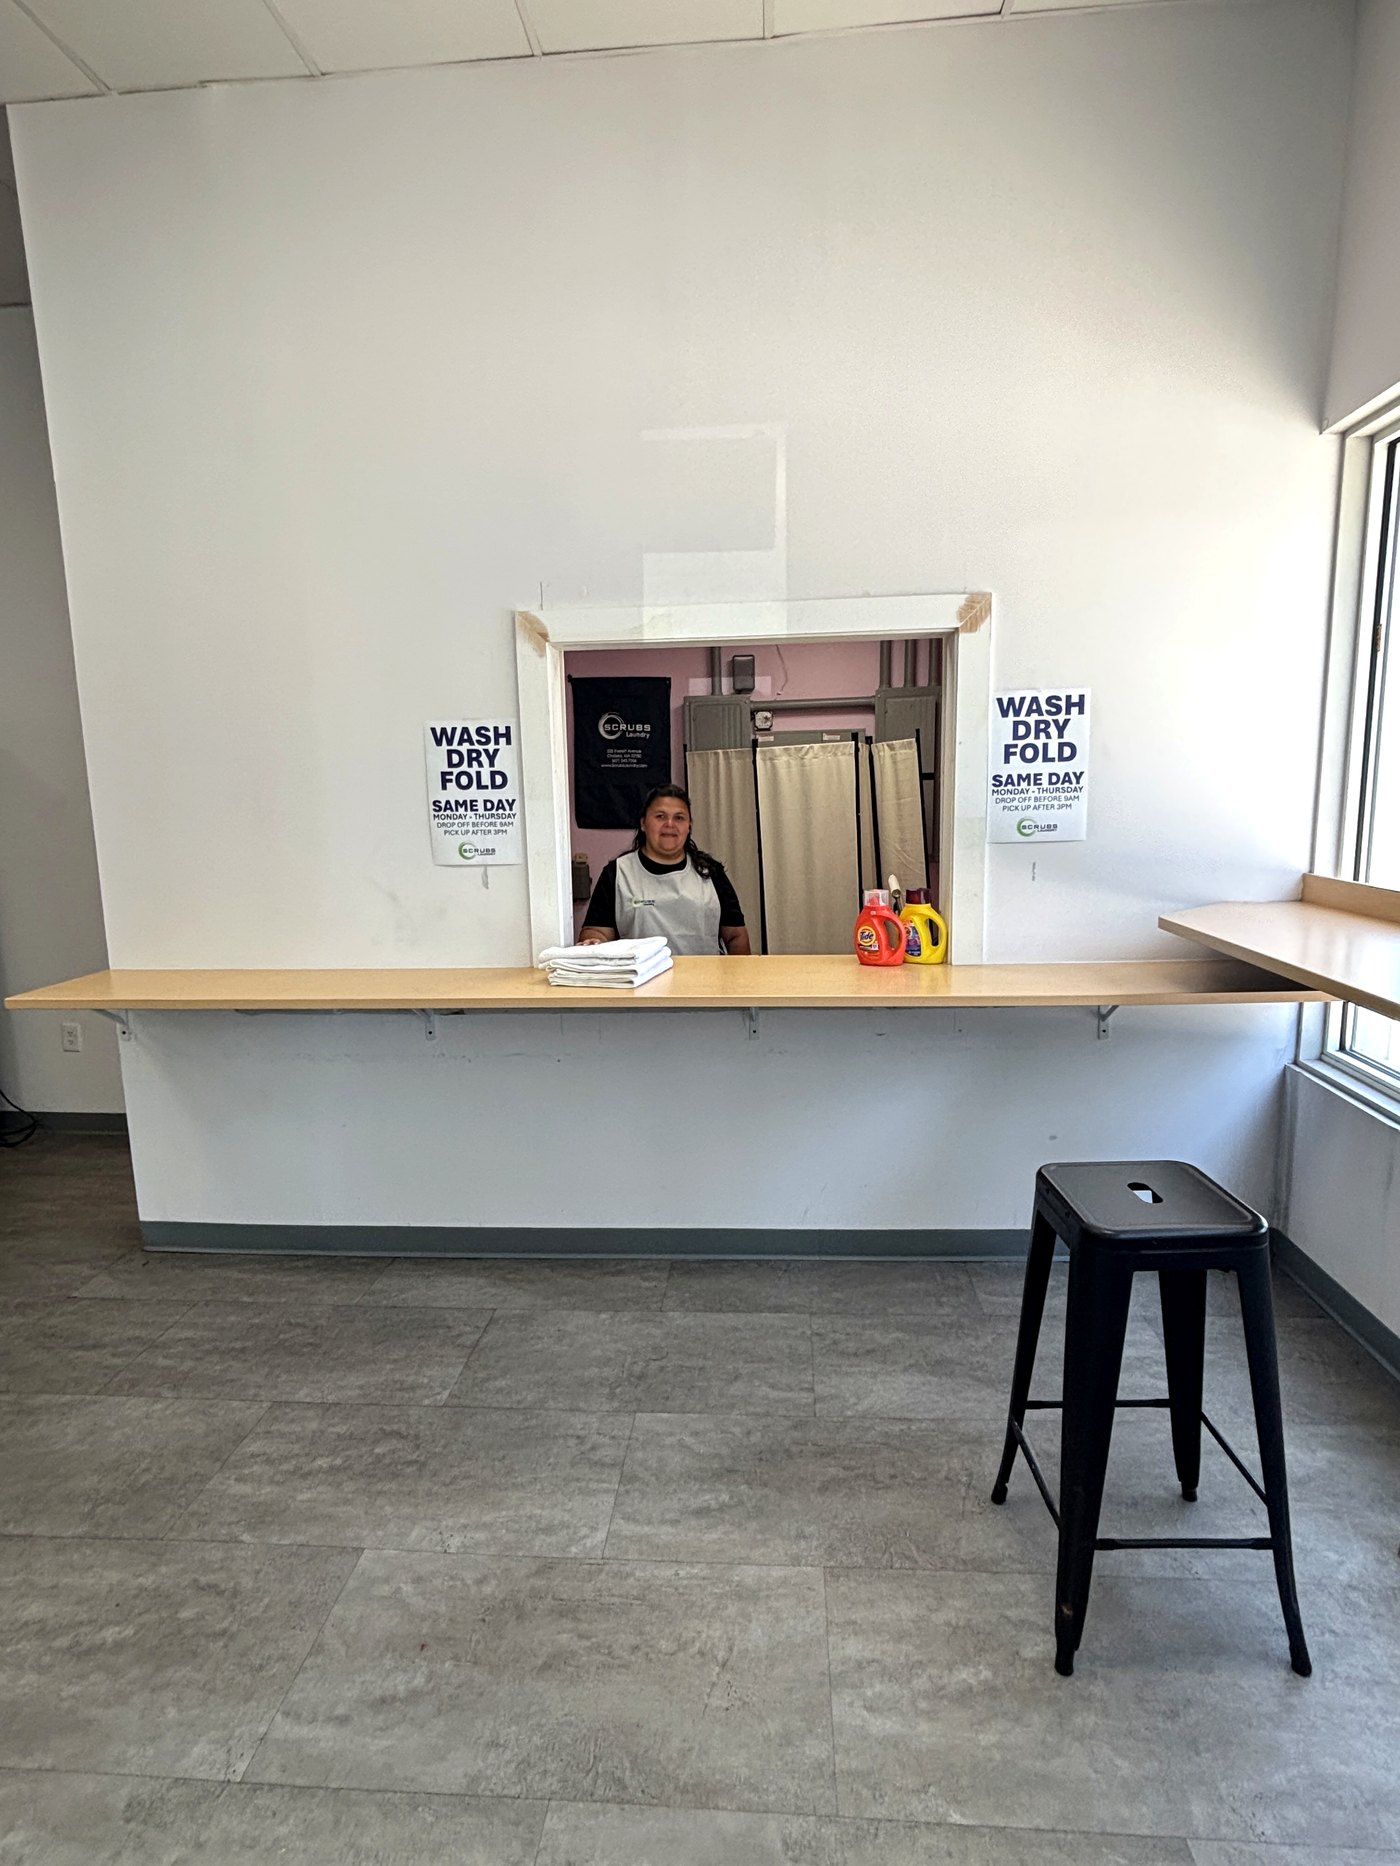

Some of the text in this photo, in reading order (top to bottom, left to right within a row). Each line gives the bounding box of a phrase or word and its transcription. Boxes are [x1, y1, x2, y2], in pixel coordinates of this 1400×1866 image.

[996, 694, 1085, 718] WASH
[604, 723, 651, 731] SCRUBS
[625, 731, 650, 739] Laundry
[1012, 718, 1071, 741] DRY
[430, 725, 512, 747] WASH
[446, 748, 500, 768] DRY
[1004, 742, 1077, 764] FOLD
[440, 770, 508, 790] FOLD
[991, 771, 1085, 788] SAME DAY
[991, 787, 1030, 796] MONDAY
[1036, 786, 1084, 795] THURSDAY
[432, 798, 516, 813] SAME DAY
[995, 796, 1016, 805] DROP
[1033, 795, 1062, 803] BEFORE
[433, 813, 468, 821] MONDAY
[474, 812, 517, 820] THURSDAY
[860, 931, 874, 941] Tide
